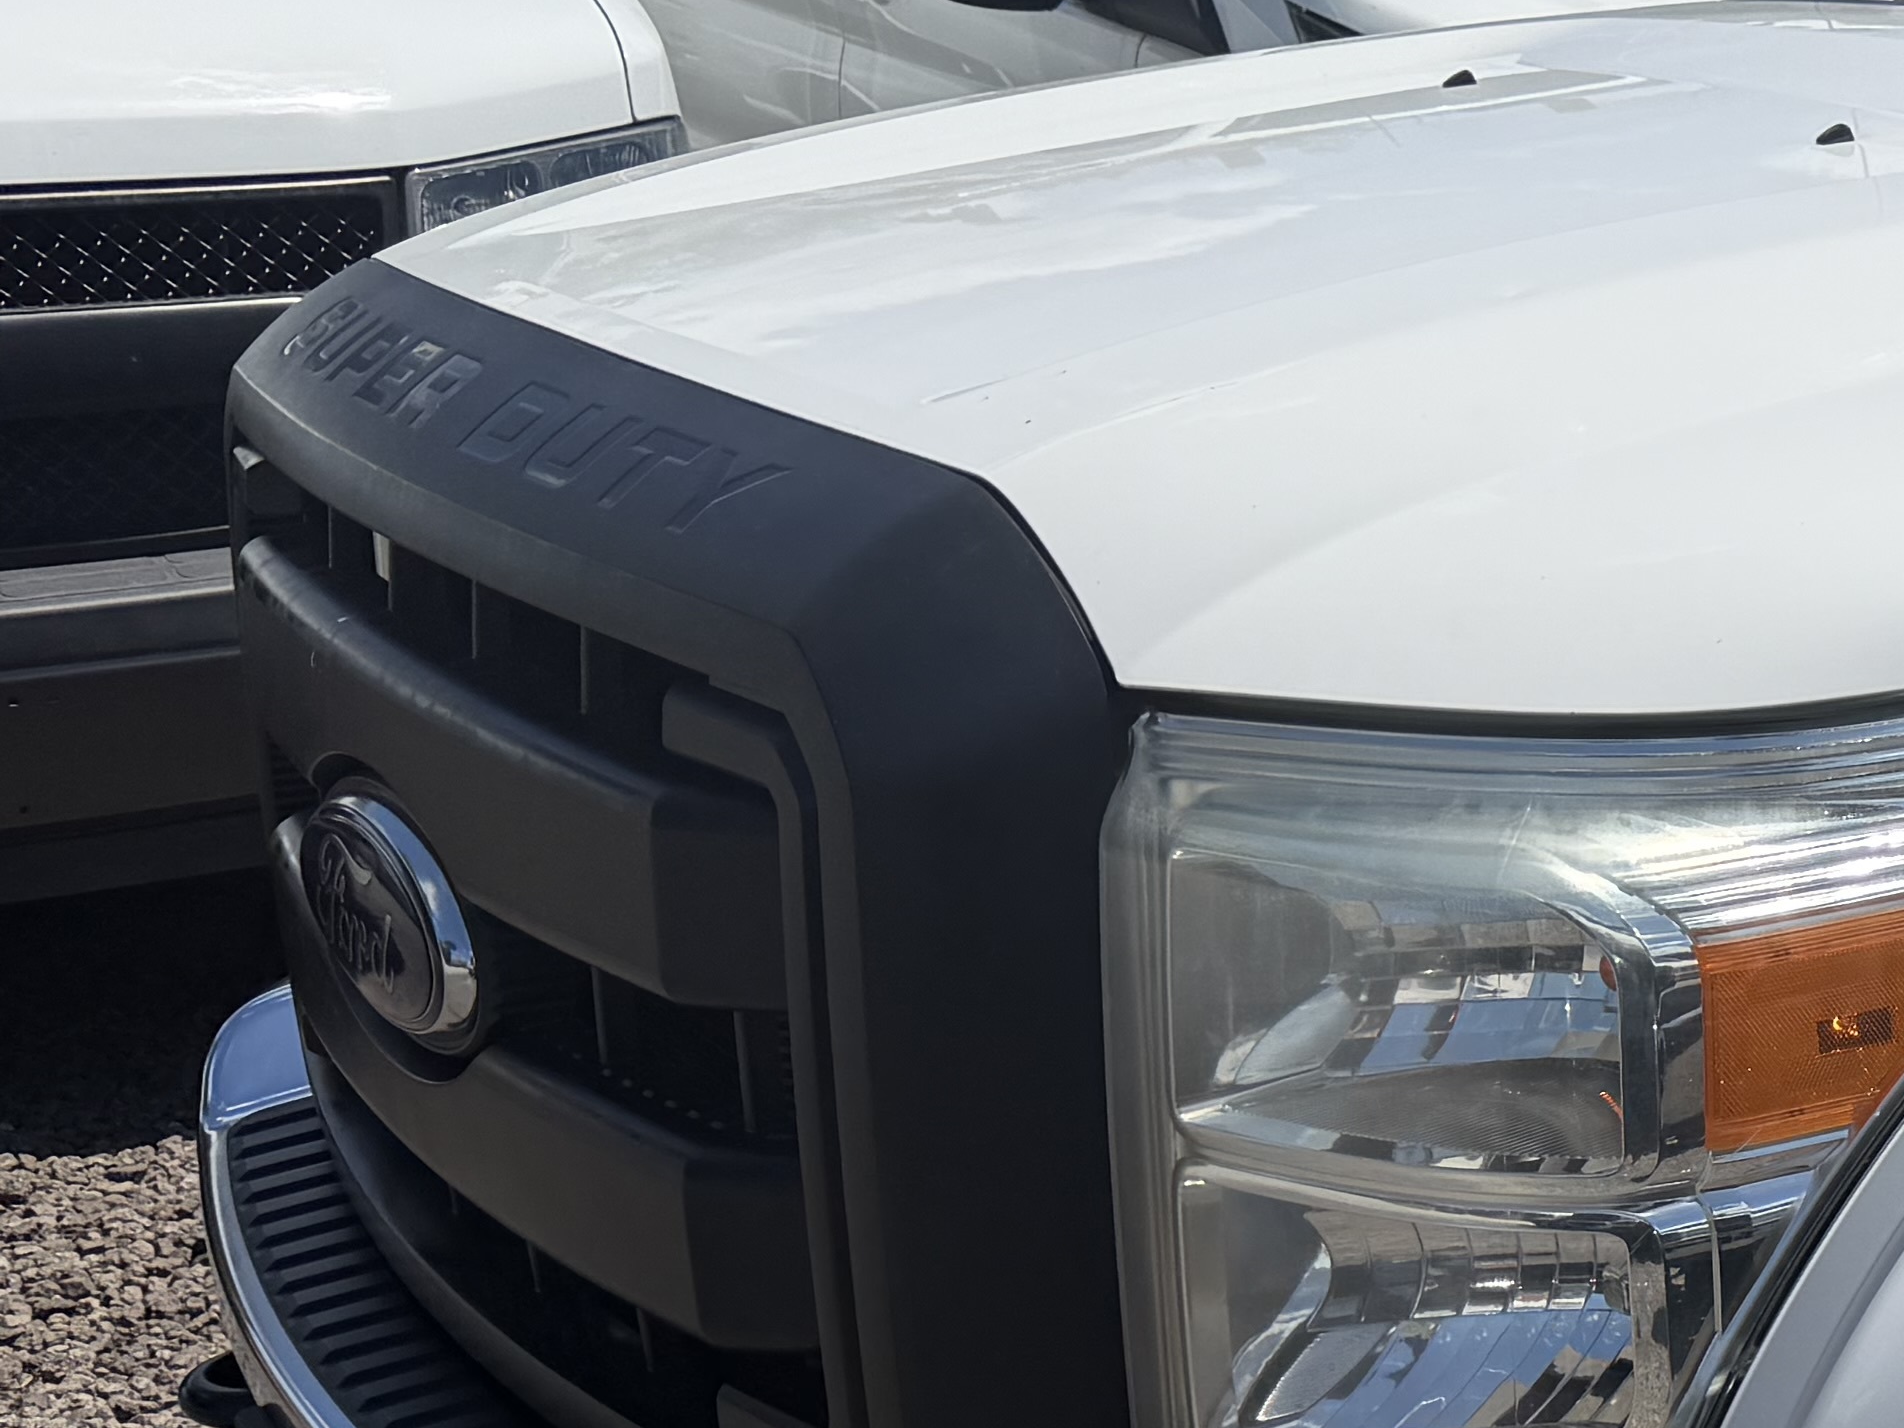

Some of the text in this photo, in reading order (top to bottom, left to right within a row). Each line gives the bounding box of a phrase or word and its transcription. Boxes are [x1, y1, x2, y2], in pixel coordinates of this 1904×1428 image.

[281, 296, 794, 535] SUPER DUTY
[316, 832, 397, 995] Ford
